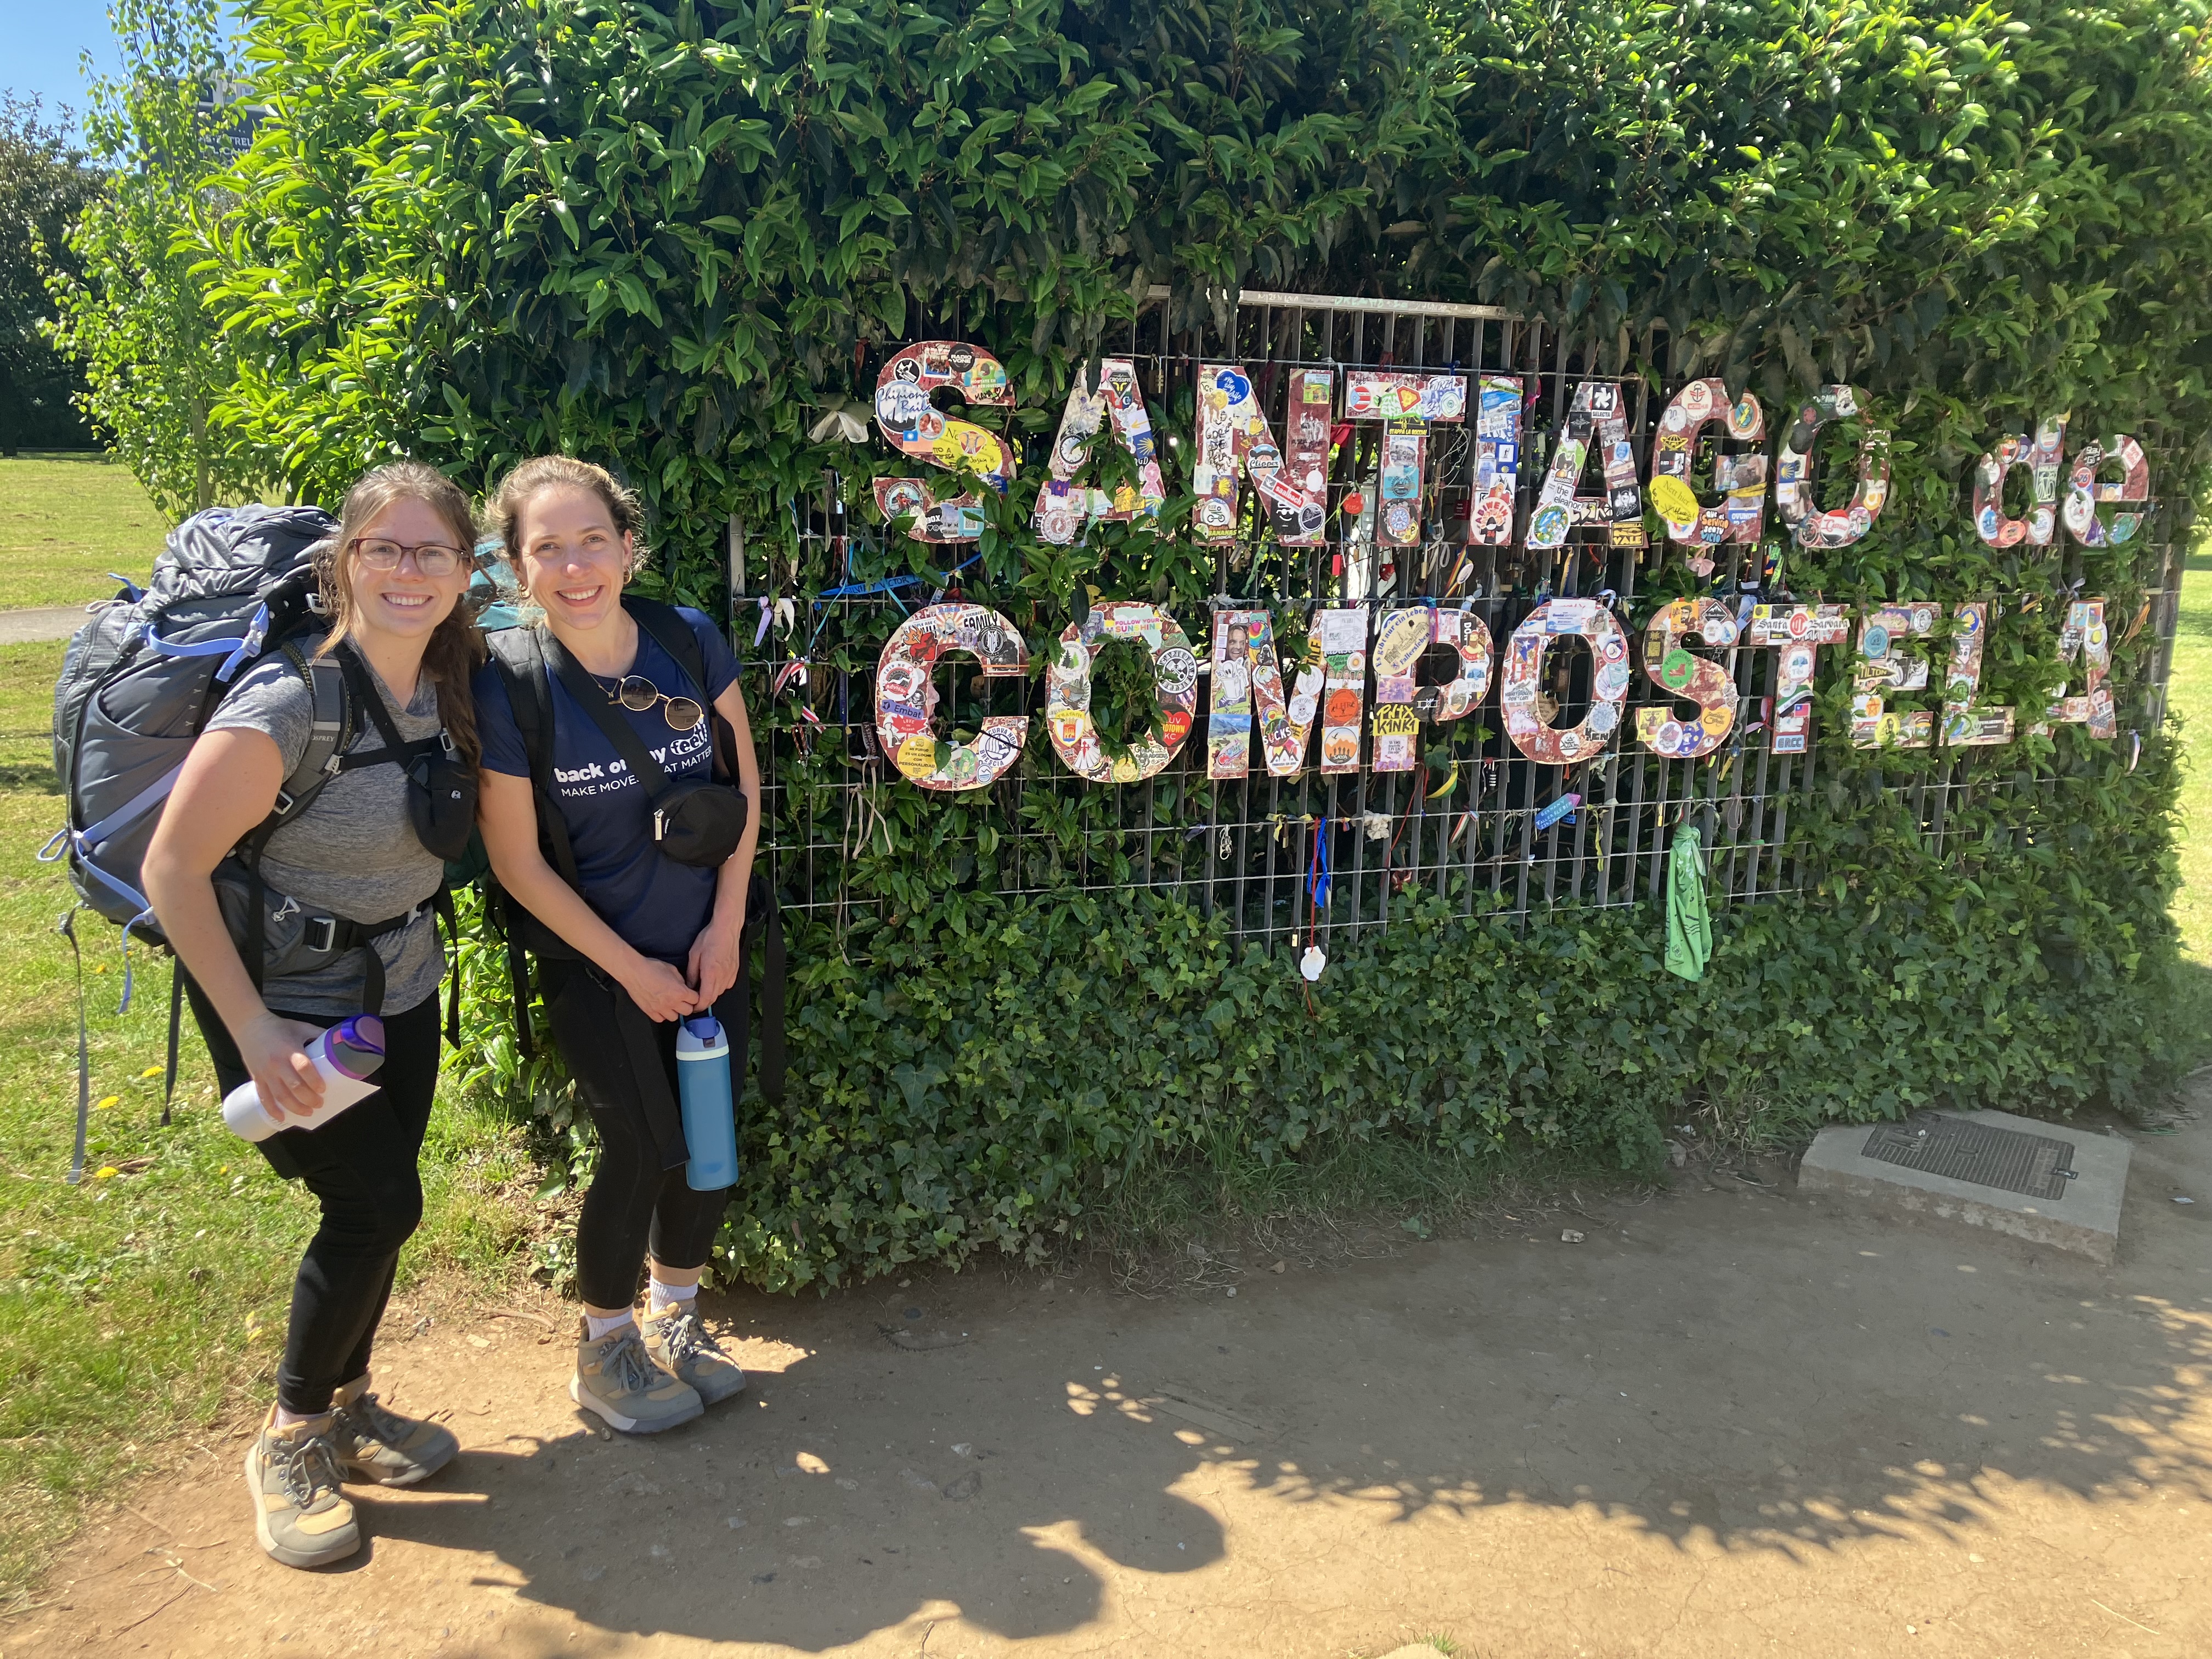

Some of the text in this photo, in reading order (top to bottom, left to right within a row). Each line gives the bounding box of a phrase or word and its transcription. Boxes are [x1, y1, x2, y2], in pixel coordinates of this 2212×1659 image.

[876, 388, 930, 402] Chipiona
[872, 340, 2149, 550] SANTIAGO de
[1249, 458, 1279, 468] Clipper
[1274, 484, 1303, 505] saalbach
[1556, 484, 1569, 496] the
[1554, 495, 1582, 511] eleanor.
[1612, 536, 1642, 545] VALE
[844, 583, 867, 594] SILVI
[879, 577, 910, 589] VCTOR
[963, 612, 998, 631] FAMILY
[1115, 623, 1162, 633] SUNSHINE
[1756, 617, 1848, 630] Santa Barbara
[1375, 607, 1429, 668] Es gibt nur ein Leben
[1399, 632, 1431, 665] Fallersleben
[1860, 666, 1887, 678] TILTON
[876, 595, 2118, 791] COMPOSTELA
[885, 682, 907, 695] Advisor
[894, 704, 922, 719] Embat
[988, 728, 1008, 738] CURVA
[1778, 737, 1802, 748] GRCC
[979, 749, 1004, 767] BRESCIA
[554, 763, 605, 783] back
[561, 785, 597, 797] MAKE
[599, 775, 640, 793] MOVE
